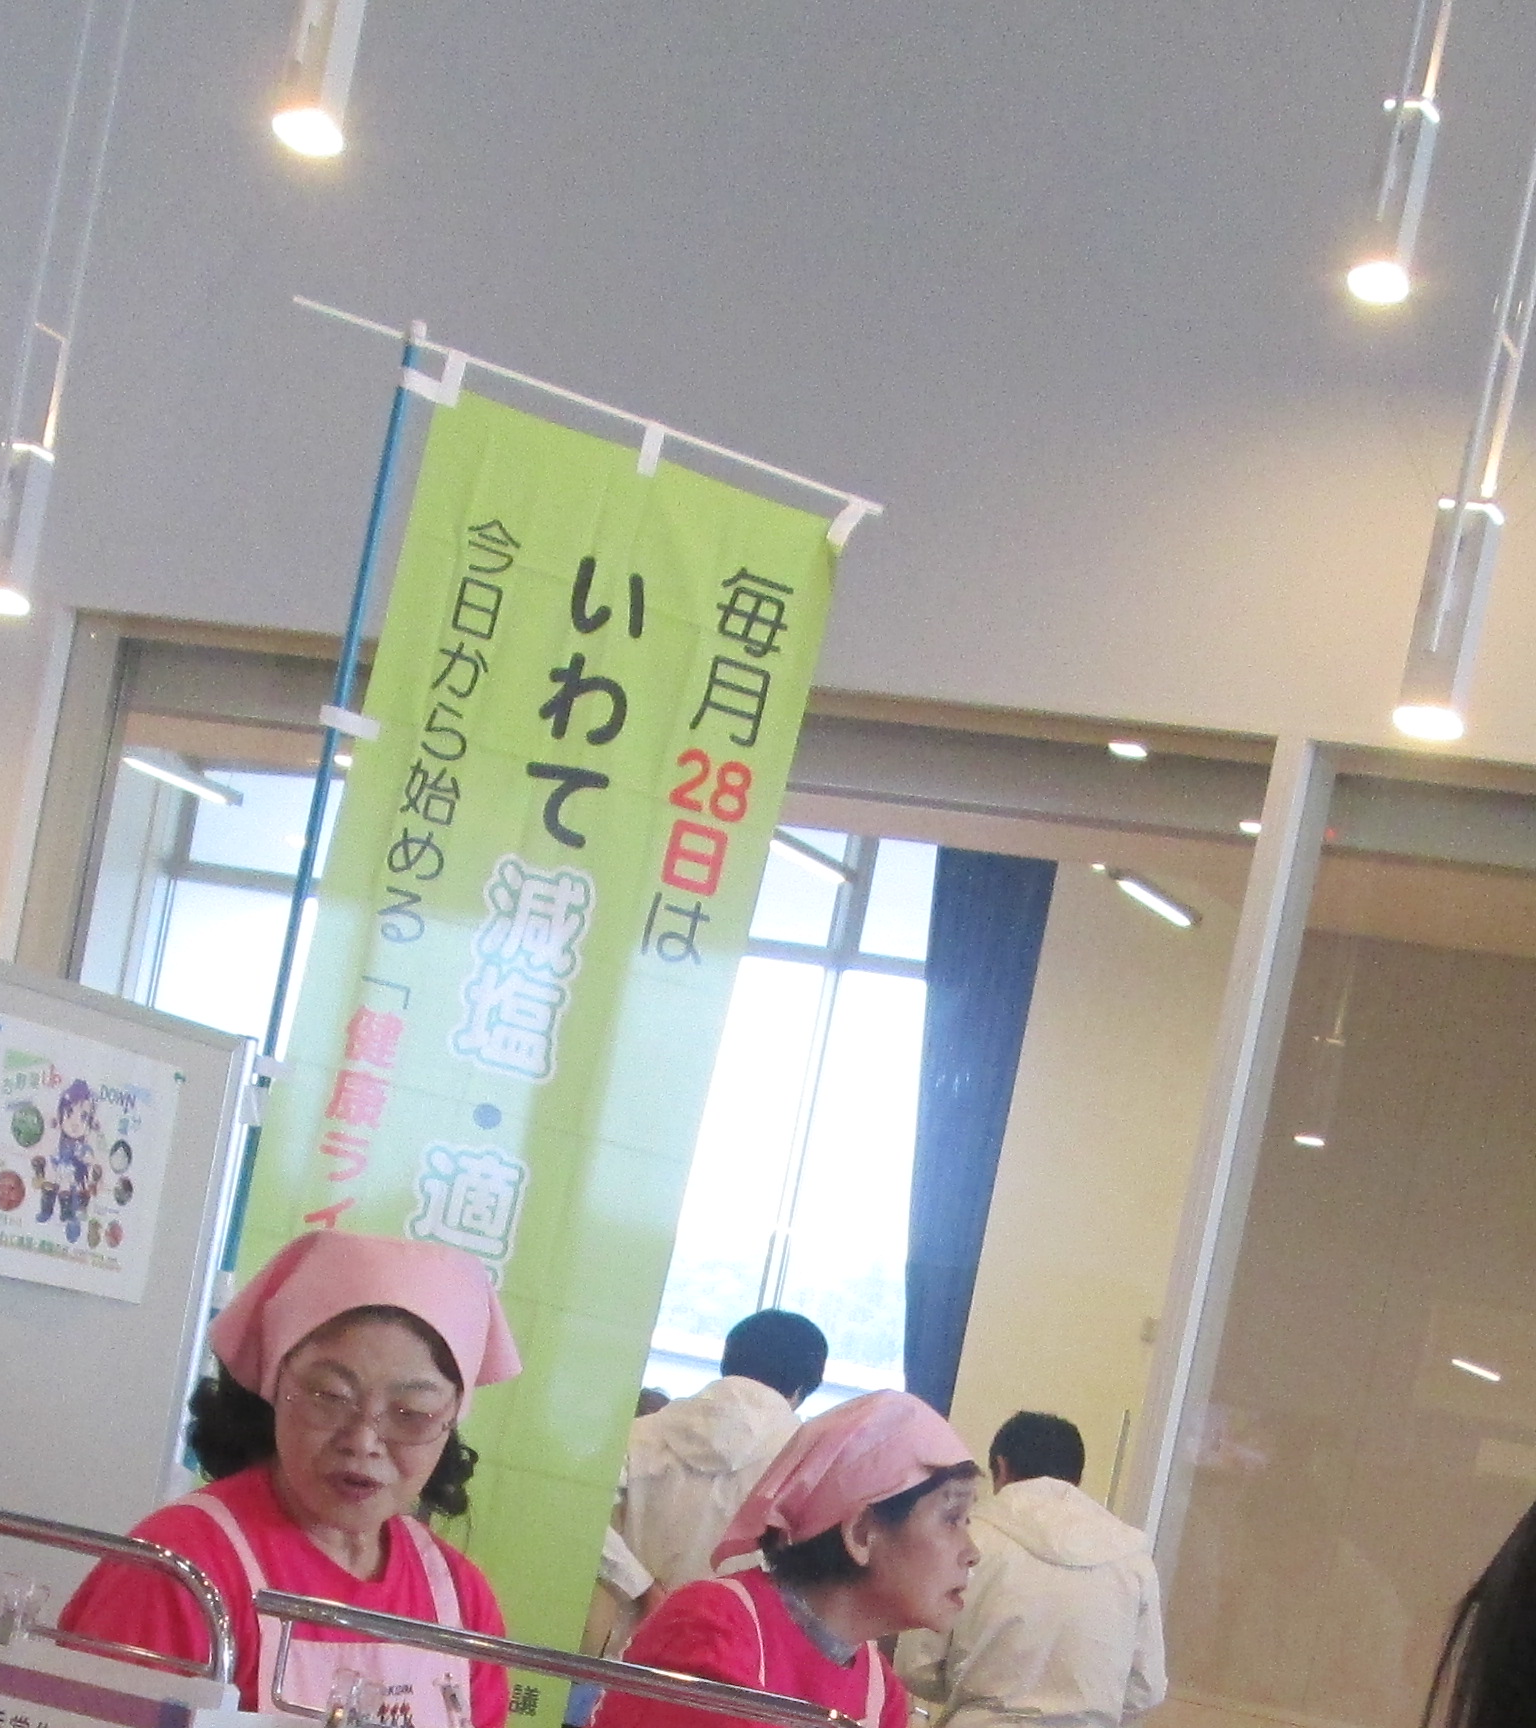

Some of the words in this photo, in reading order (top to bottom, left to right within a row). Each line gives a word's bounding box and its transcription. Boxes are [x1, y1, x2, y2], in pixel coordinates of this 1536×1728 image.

[409, 557, 644, 1287] いわて減塩・適
[640, 567, 794, 965] 毎月28日は
